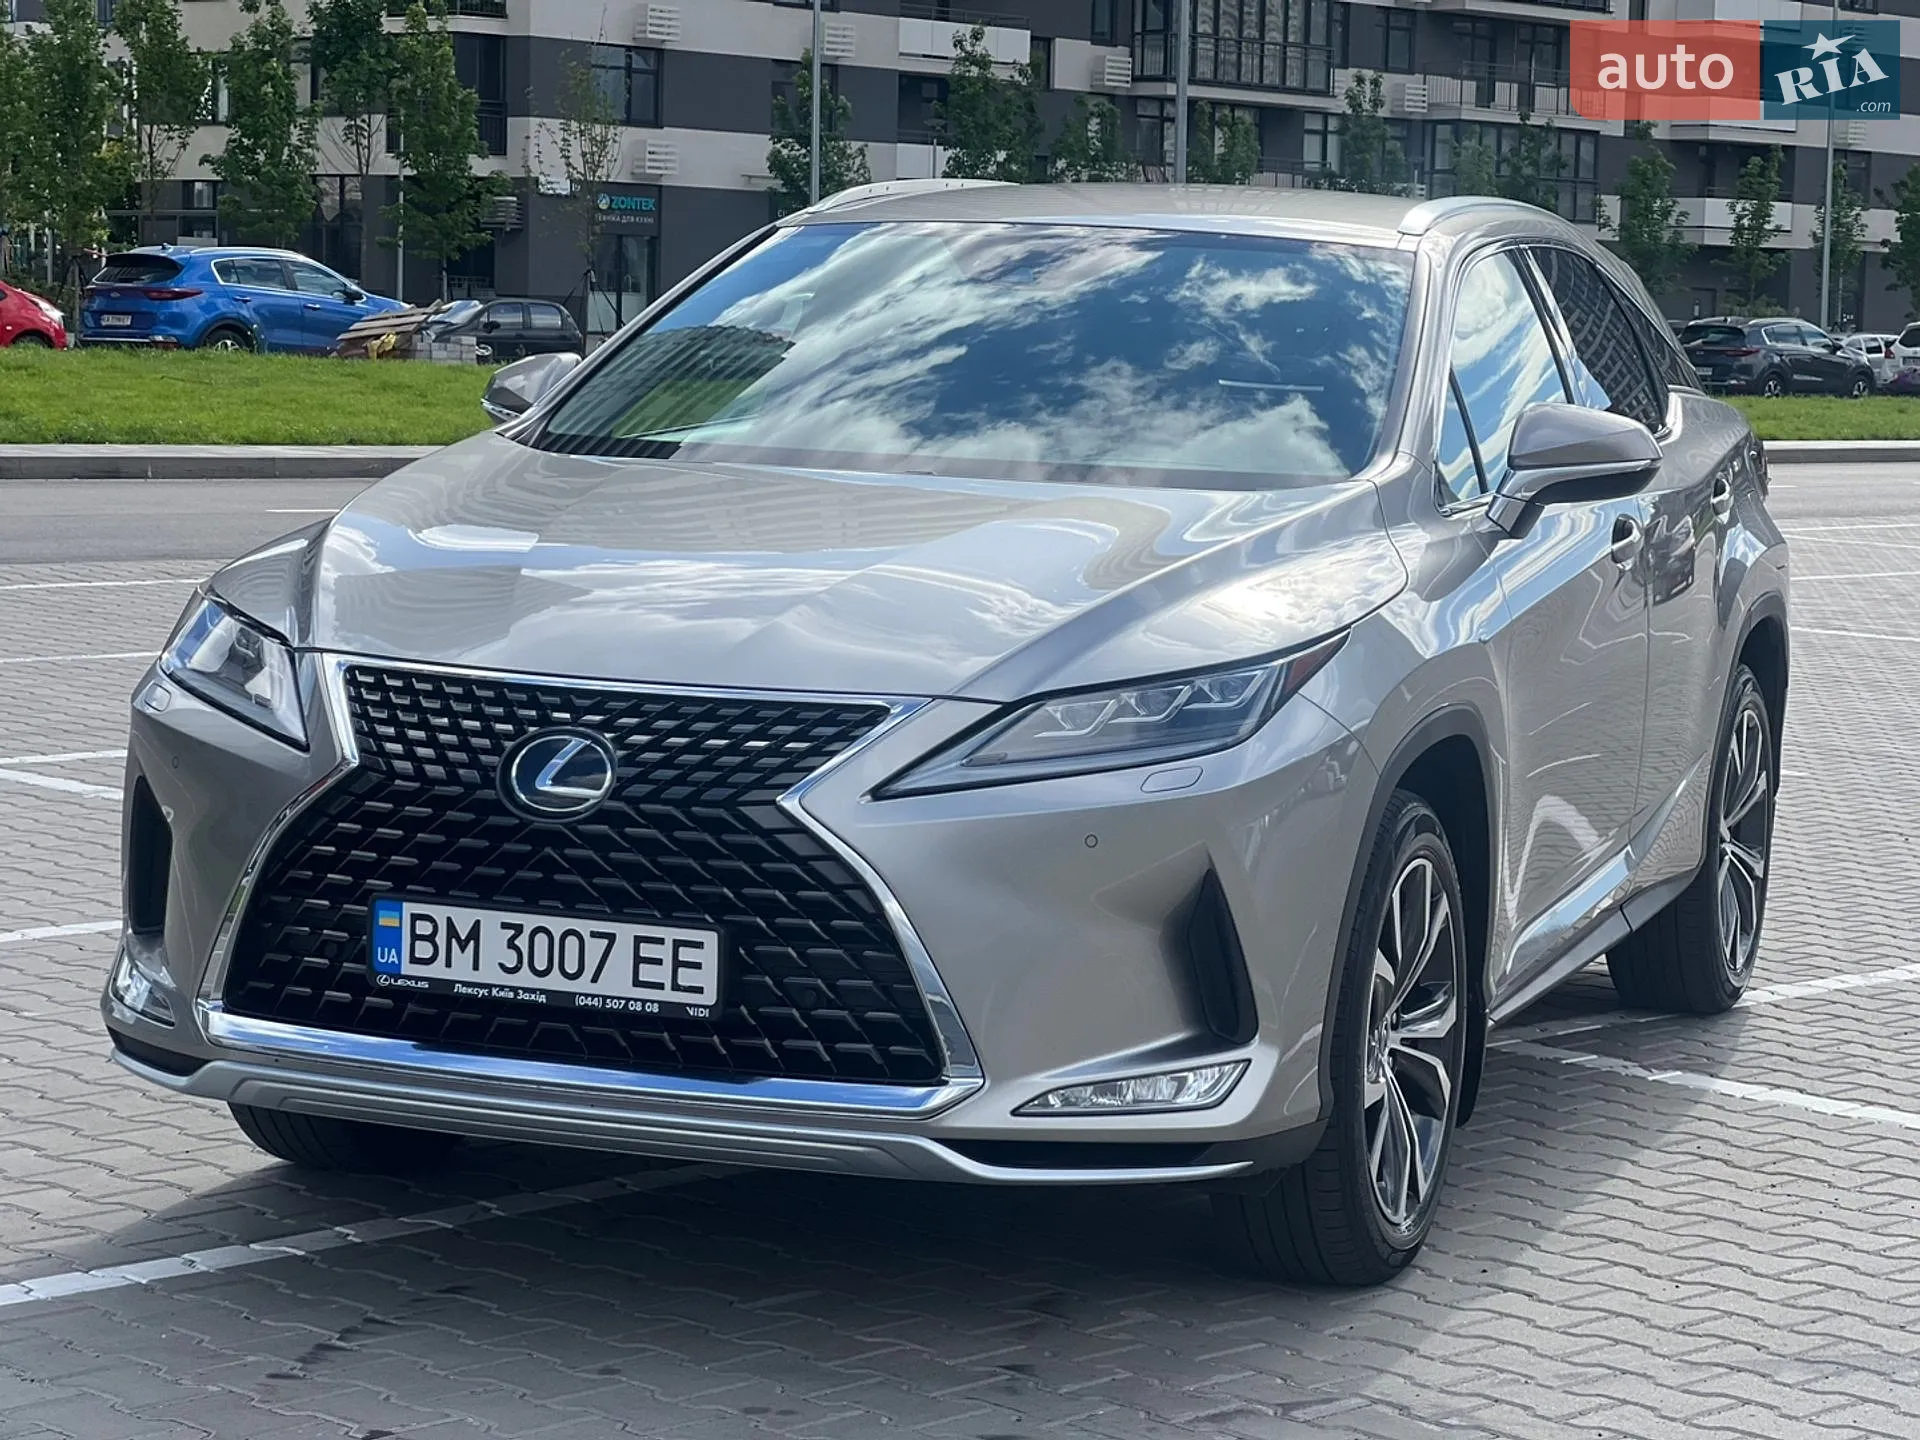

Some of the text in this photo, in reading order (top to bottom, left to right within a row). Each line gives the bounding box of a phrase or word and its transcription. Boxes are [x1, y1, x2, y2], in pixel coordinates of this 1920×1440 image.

[611, 196, 656, 211] ZONTEK
[377, 947, 399, 964] UA
[408, 912, 705, 995] BM 3007 EE
[390, 977, 430, 988] LEXUS
[453, 983, 547, 1003] Лексус Київ Захід
[575, 994, 660, 1013] (044) 507 08 08
[685, 1006, 710, 1018] VIDI
